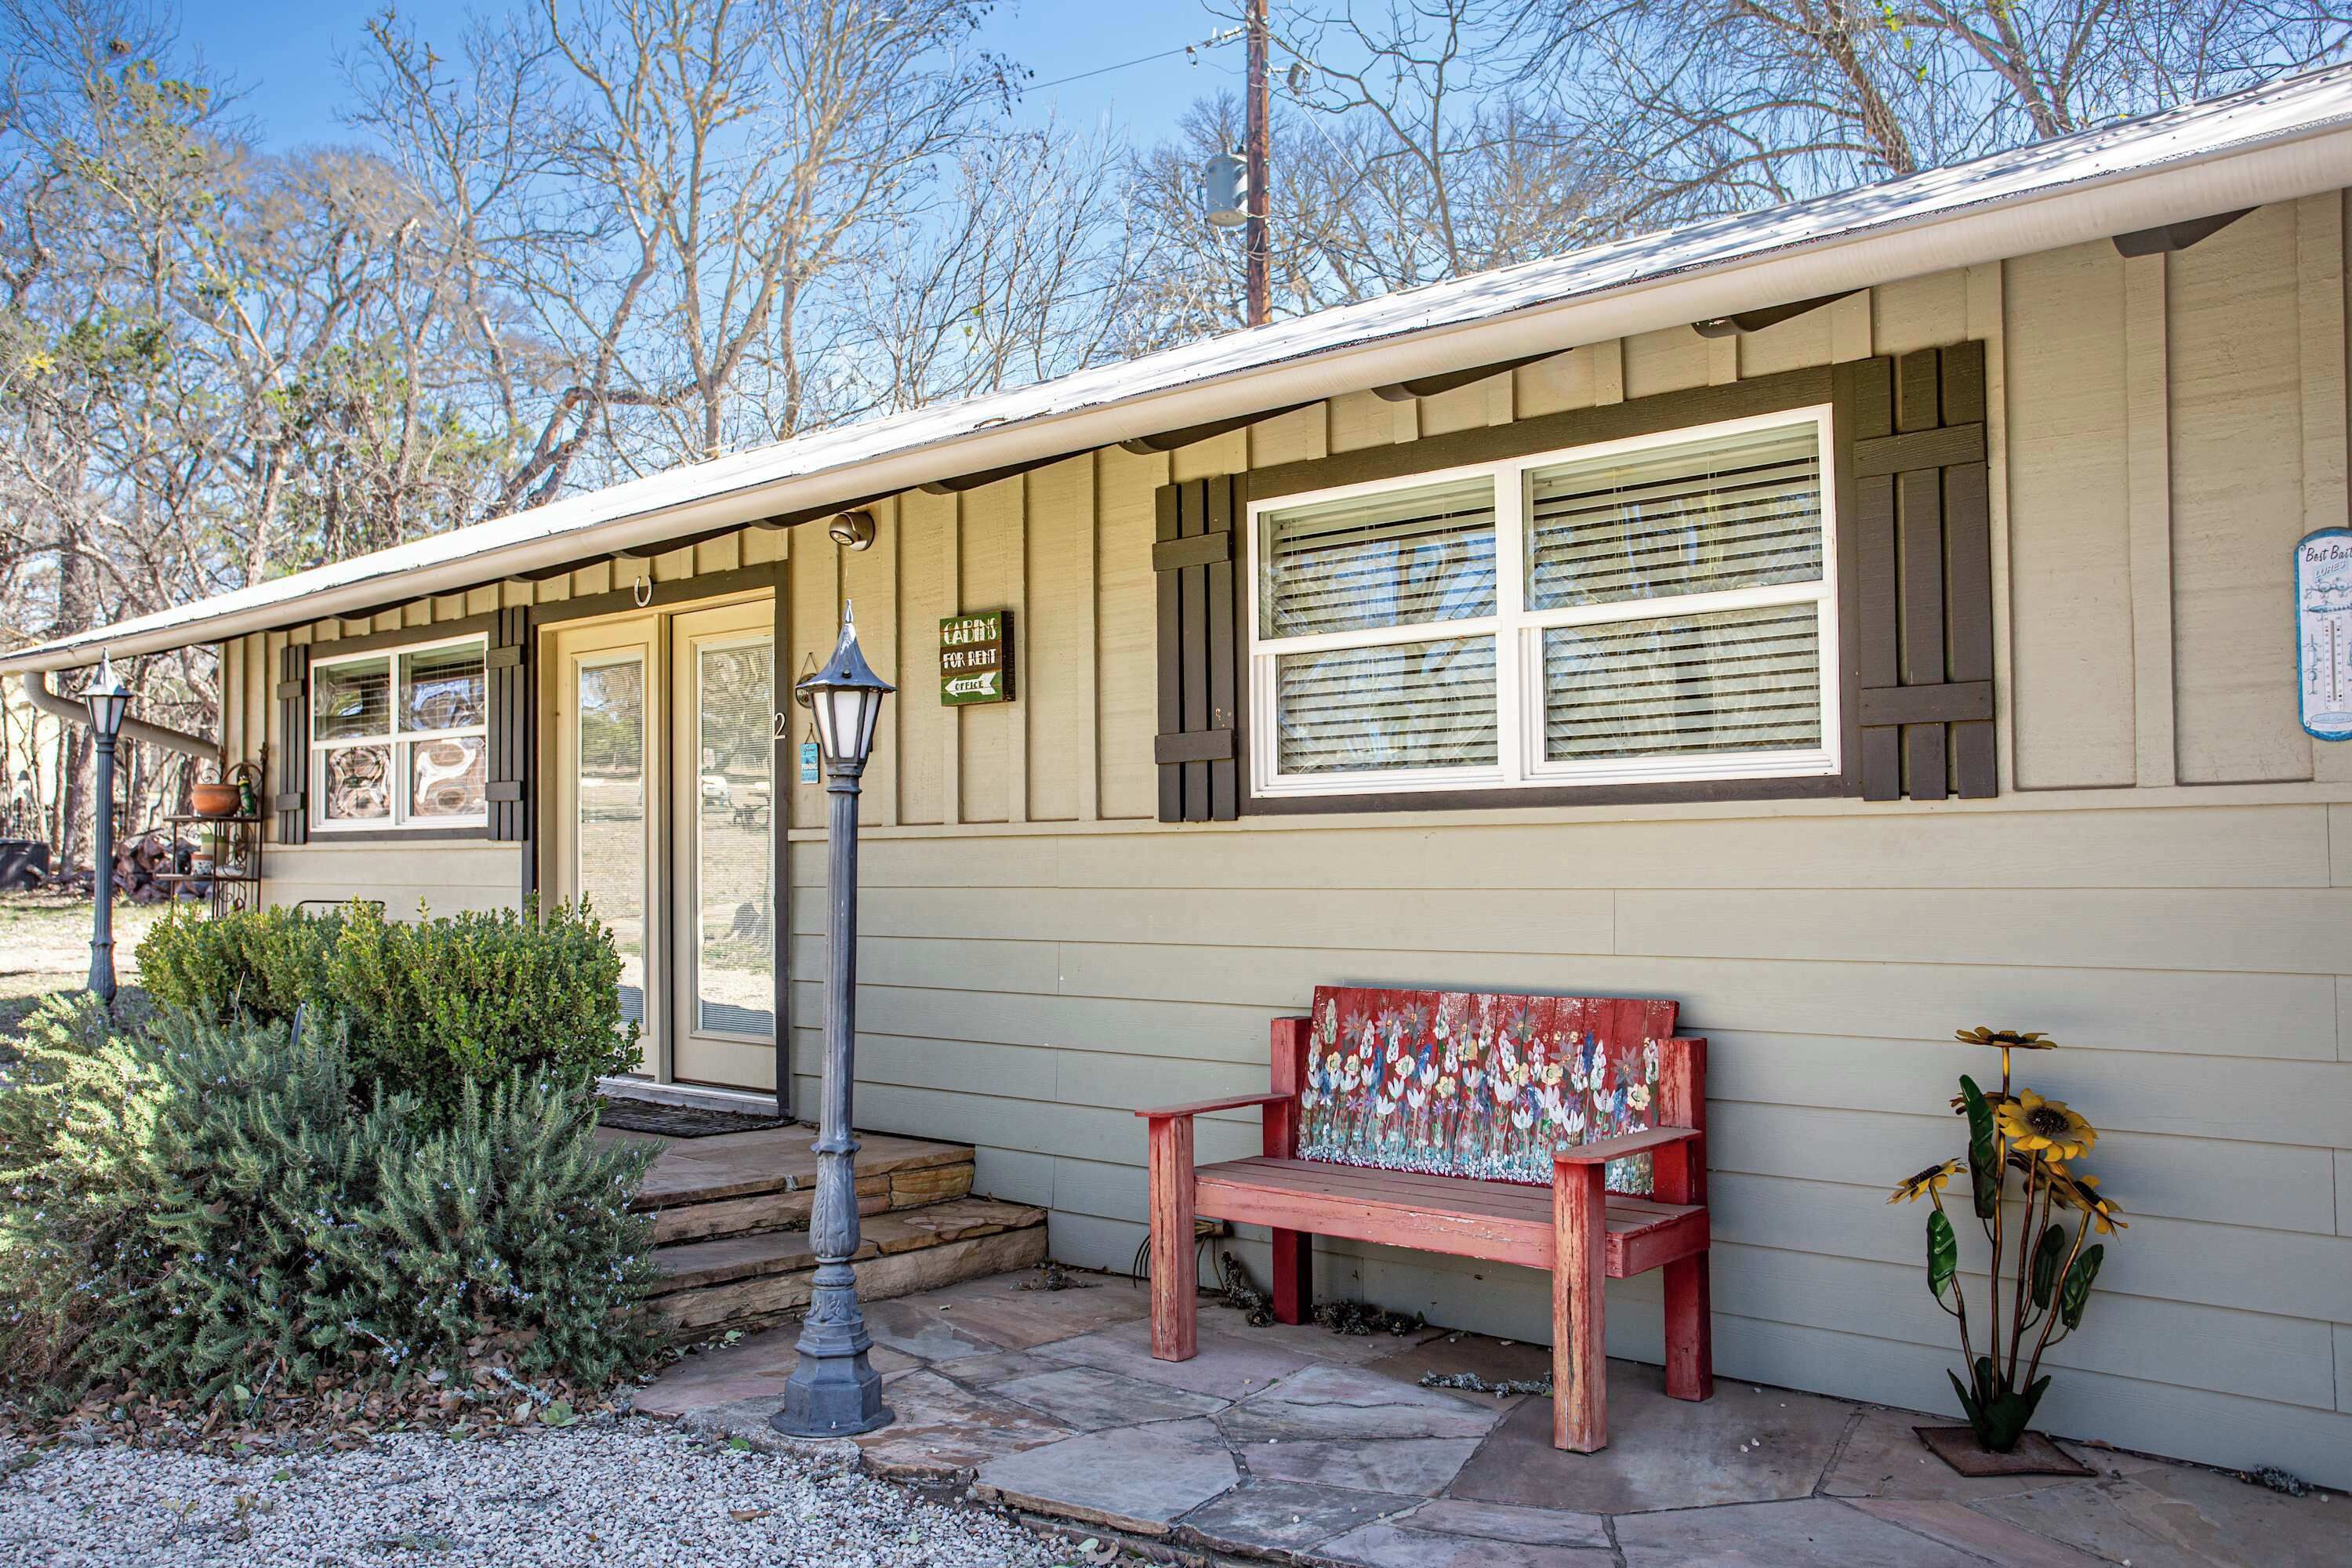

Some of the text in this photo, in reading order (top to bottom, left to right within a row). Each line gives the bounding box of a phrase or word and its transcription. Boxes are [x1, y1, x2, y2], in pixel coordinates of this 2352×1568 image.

[2306, 547, 2329, 562] Best
[2315, 561, 2346, 578] LURES
[944, 618, 997, 644] CABINS
[943, 648, 996, 669] FOR RENT
[955, 681, 984, 691] OFFICE
[775, 712, 786, 740] 2
